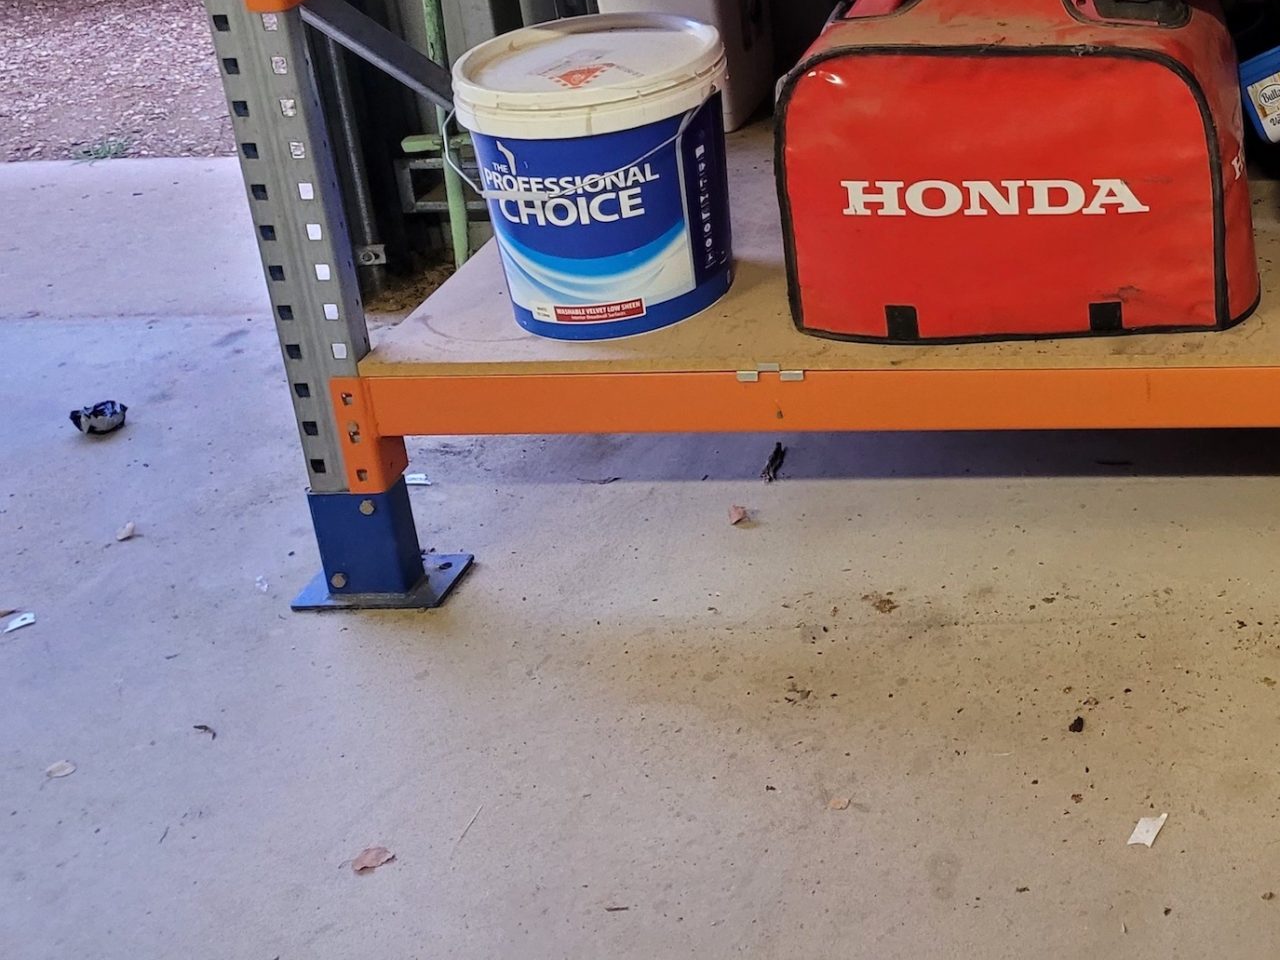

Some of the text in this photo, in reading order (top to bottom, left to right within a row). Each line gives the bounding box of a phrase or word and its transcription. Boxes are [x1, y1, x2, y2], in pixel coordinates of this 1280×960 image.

[483, 163, 660, 196] PROFESSIONAL
[492, 162, 509, 174] THE
[499, 187, 645, 227] CHOICE
[841, 178, 1150, 217] HONDA
[556, 307, 586, 316] WASHABLE
[586, 306, 607, 315] VELVET
[607, 304, 621, 312] LOW
[621, 301, 641, 311] SHEEN
